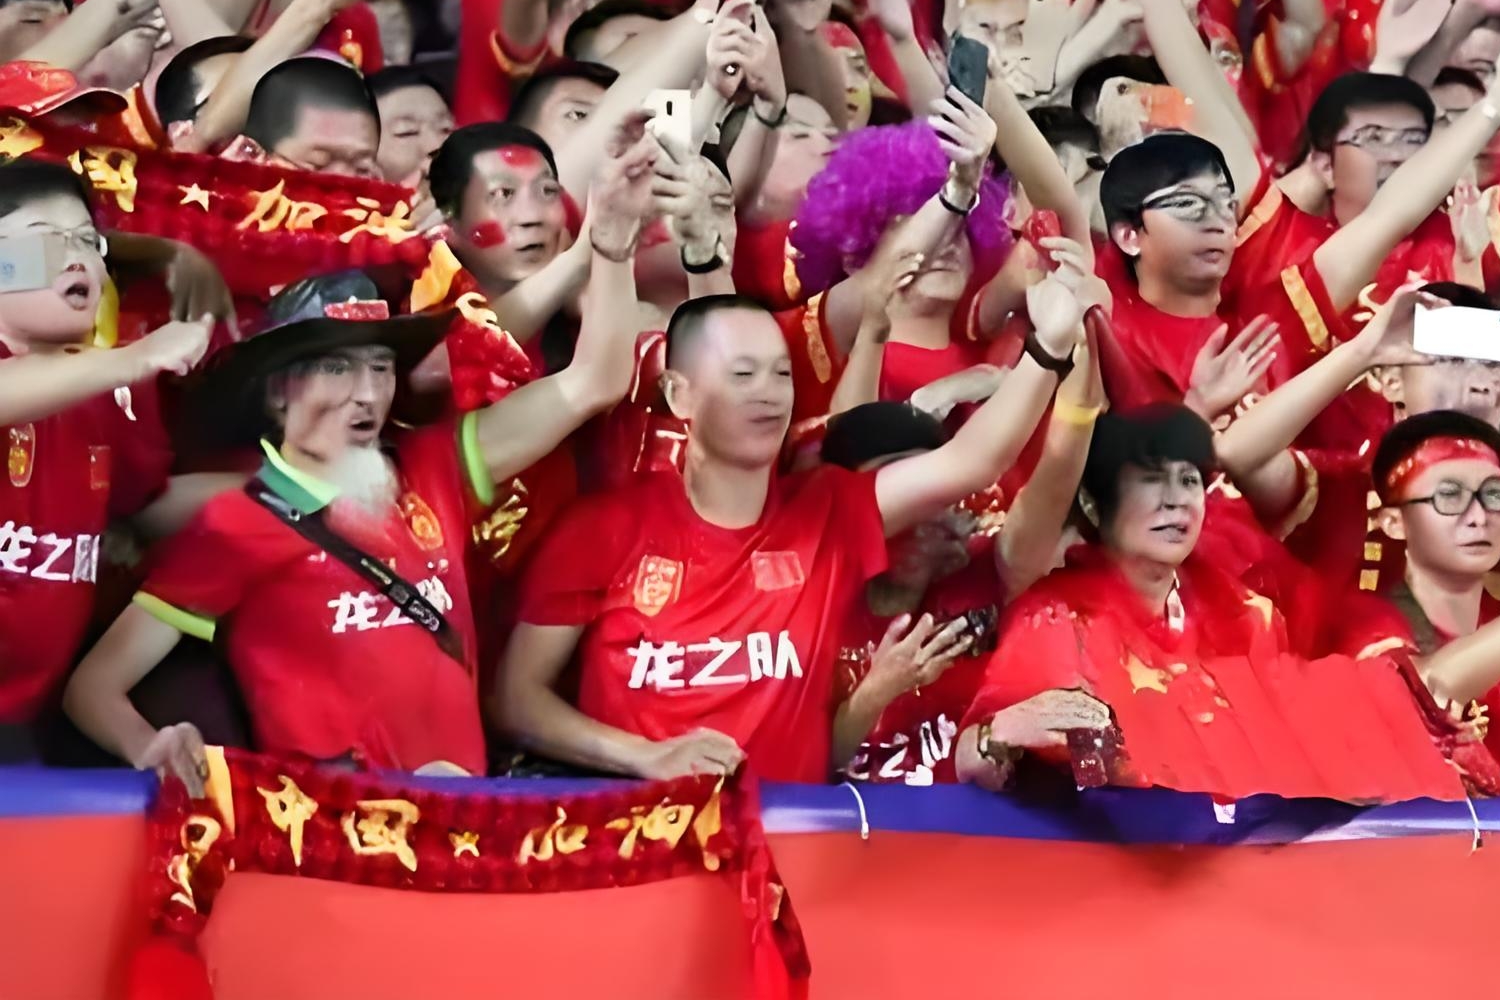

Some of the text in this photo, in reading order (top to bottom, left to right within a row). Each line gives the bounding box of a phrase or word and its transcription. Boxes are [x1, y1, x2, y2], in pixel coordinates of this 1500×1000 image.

[625, 629, 804, 692] 龙之队
[256, 774, 420, 873] 中国
[517, 797, 695, 866] 加油
